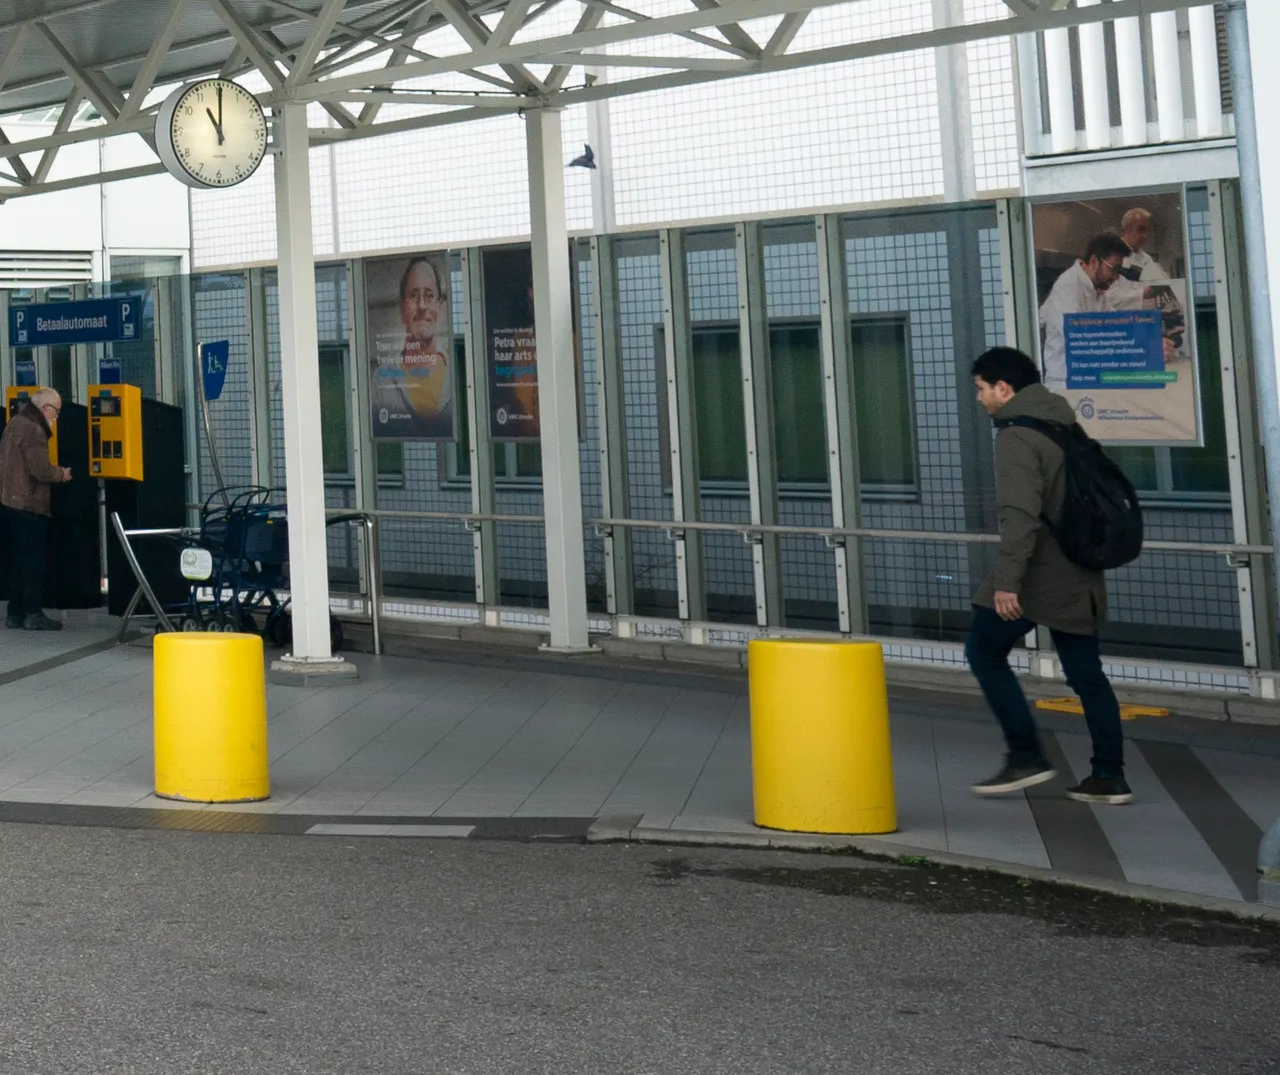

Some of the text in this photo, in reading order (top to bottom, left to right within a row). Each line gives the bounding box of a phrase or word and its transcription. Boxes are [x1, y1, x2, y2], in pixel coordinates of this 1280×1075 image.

[196, 93, 204, 103] 11
[184, 106, 193, 116] 10
[248, 108, 255, 119] 2
[254, 129, 260, 140] 3
[184, 148, 190, 158] 8
[248, 152, 254, 161] 4
[198, 162, 204, 172] 7
[235, 165, 241, 175] 5
[216, 169, 222, 179] 6
[122, 303, 131, 321] P
[36, 314, 108, 332] Betaalautomaat
[406, 342, 421, 350] een
[494, 337, 538, 348] Petra vraa
[405, 352, 437, 365] mening
[494, 349, 532, 361] haar arts
